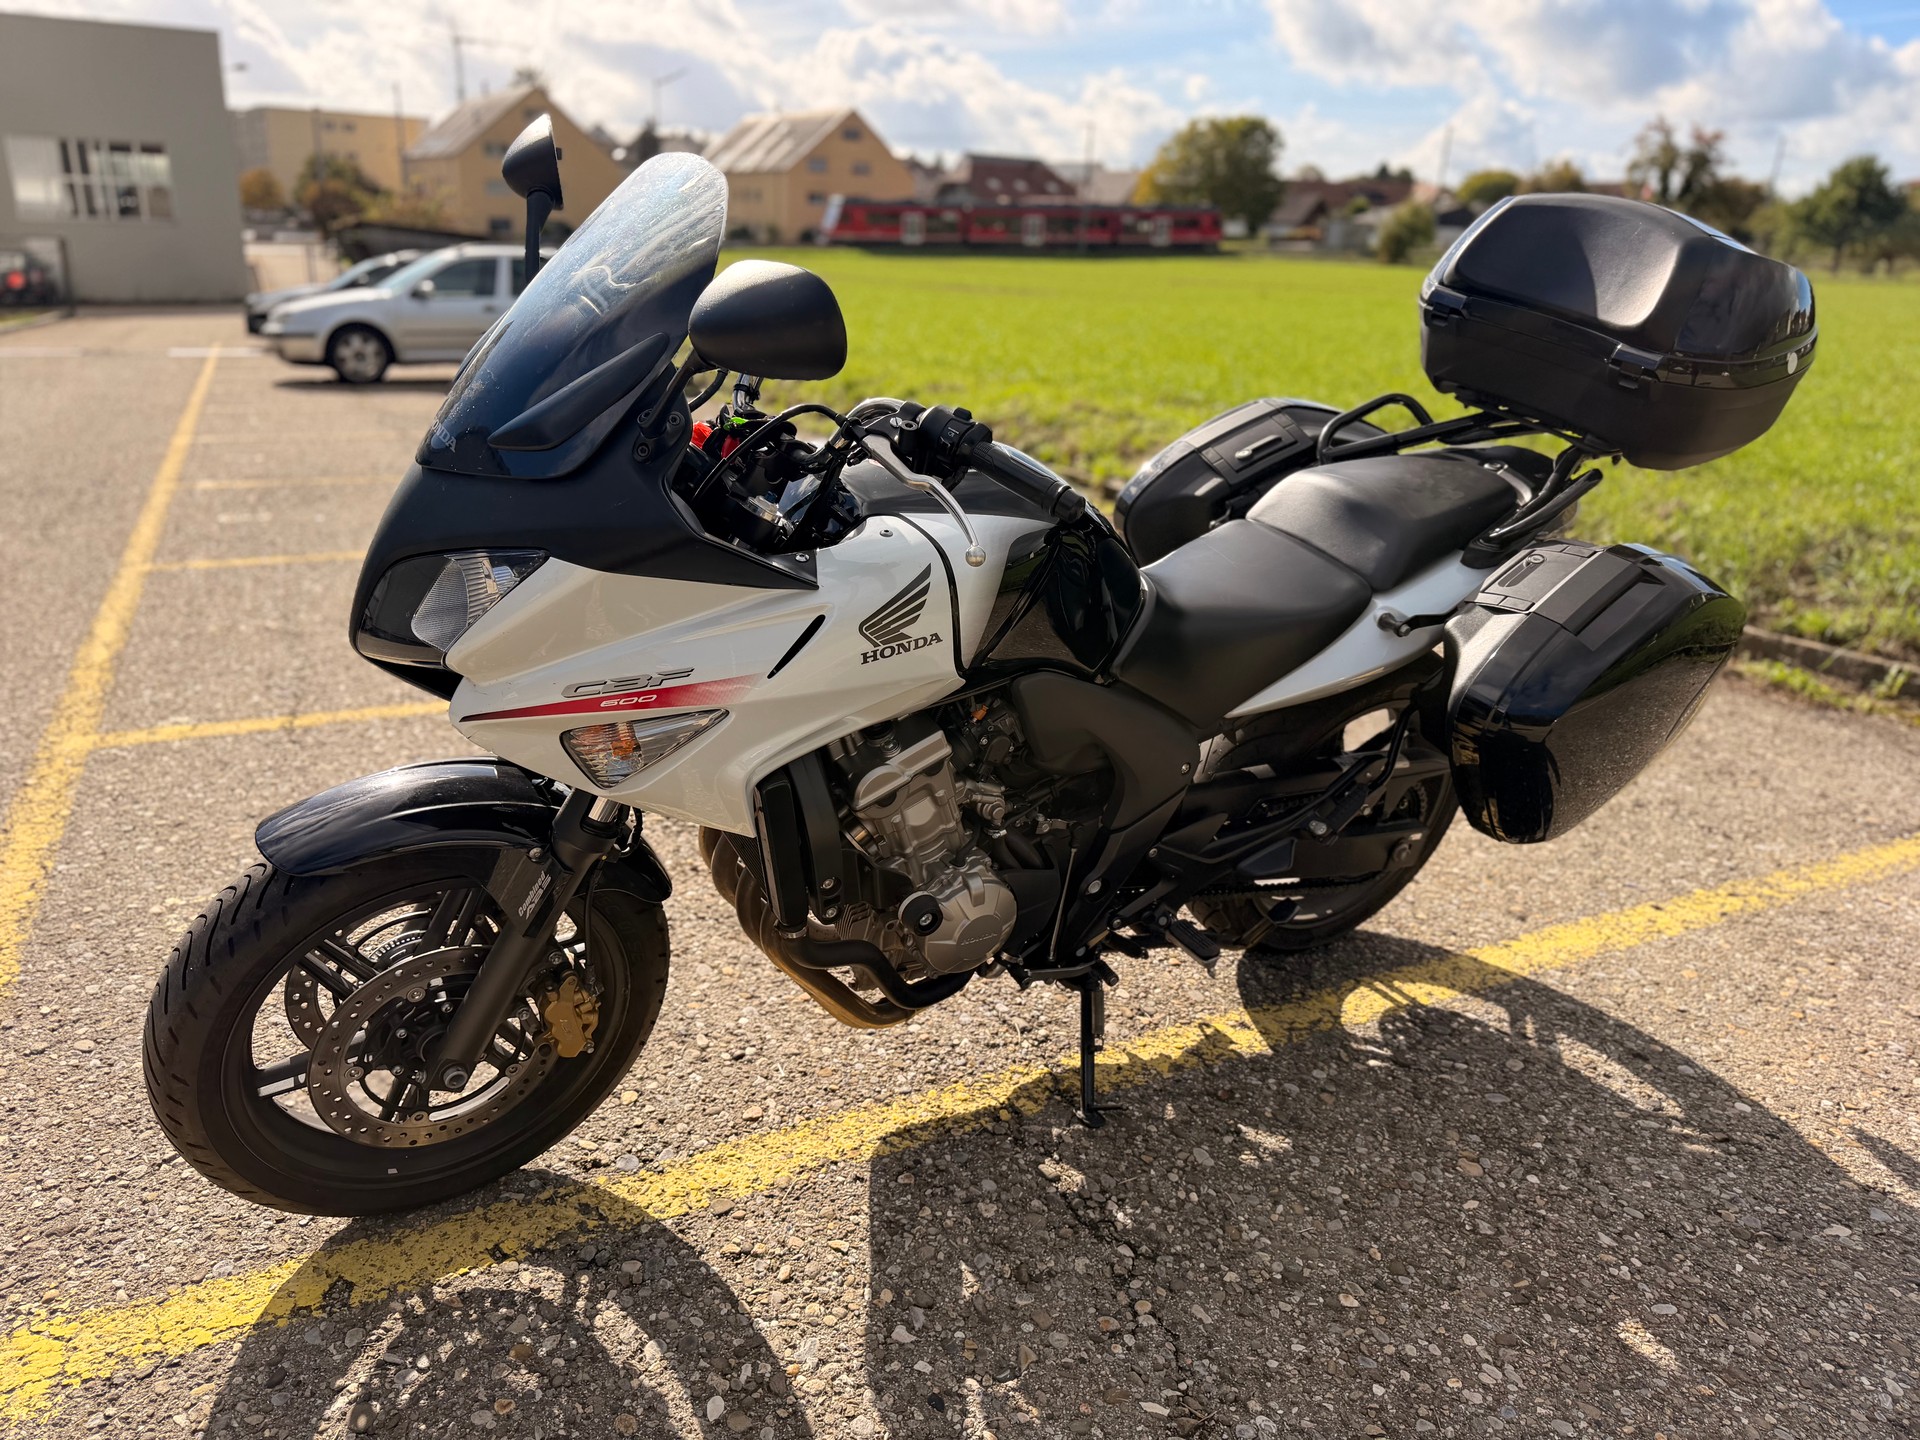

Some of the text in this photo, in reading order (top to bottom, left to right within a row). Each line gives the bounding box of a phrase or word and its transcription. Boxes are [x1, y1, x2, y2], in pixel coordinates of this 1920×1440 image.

[431, 419, 456, 453] ONDA
[861, 633, 943, 665] HONDA
[561, 667, 695, 698] CBF
[600, 694, 657, 707] 600
[518, 870, 546, 917] Combined
[525, 874, 552, 920] ABS
